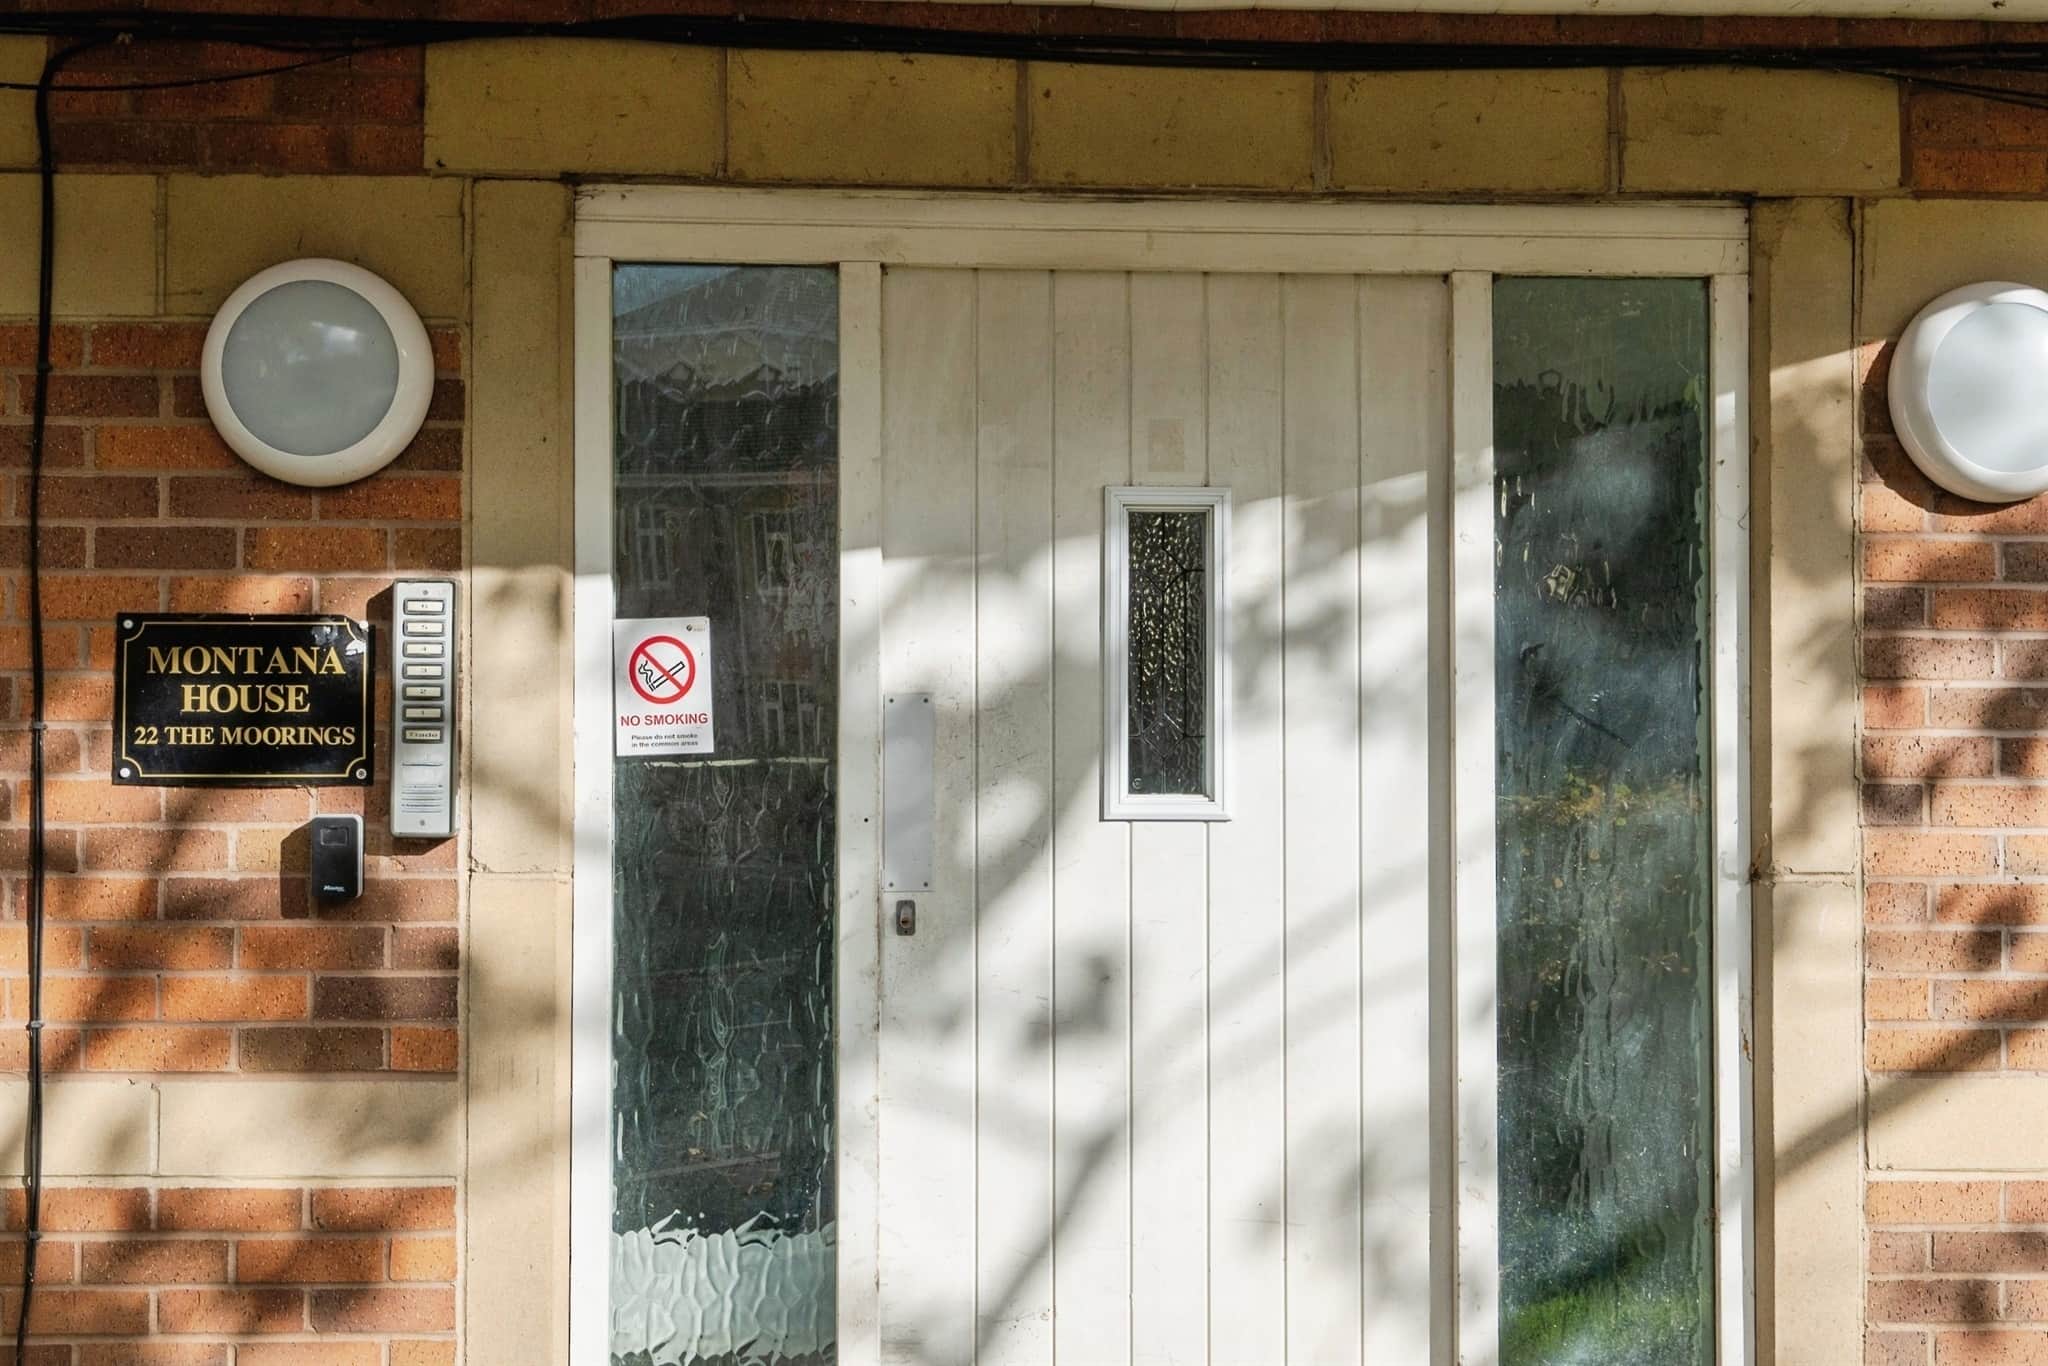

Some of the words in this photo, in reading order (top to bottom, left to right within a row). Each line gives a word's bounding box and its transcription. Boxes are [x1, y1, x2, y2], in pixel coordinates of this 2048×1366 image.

[148, 646, 346, 674] MONTANA
[180, 684, 310, 713] HOUSE
[621, 715, 641, 726] NO
[644, 713, 708, 725] SMOKING
[134, 727, 159, 746] 22
[164, 726, 215, 745] THE
[221, 726, 356, 746] MOORINGS
